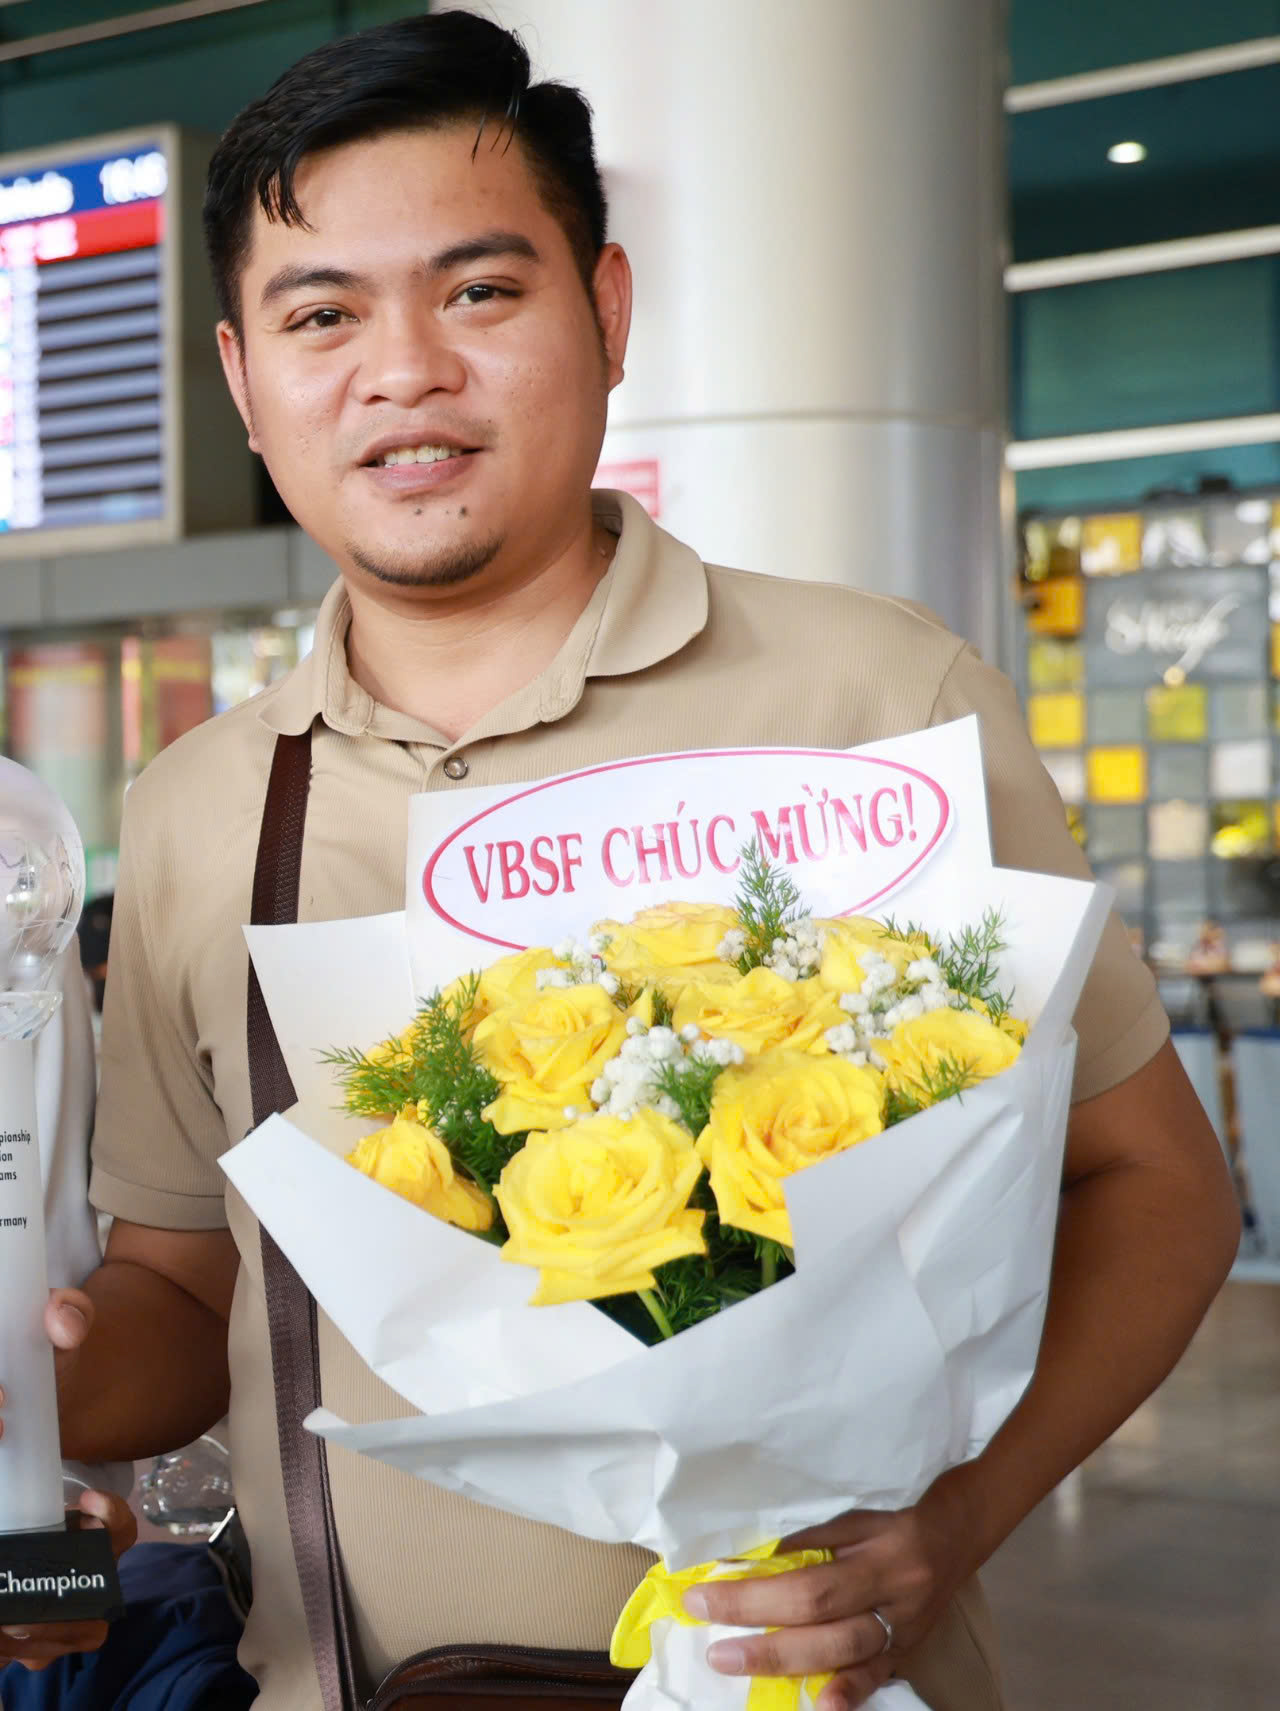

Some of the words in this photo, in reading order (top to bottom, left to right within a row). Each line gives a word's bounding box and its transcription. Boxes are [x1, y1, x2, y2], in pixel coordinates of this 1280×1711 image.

[463, 834, 582, 904] VBSF
[601, 802, 742, 888] CHÚC
[750, 783, 917, 866] MỪNG!
